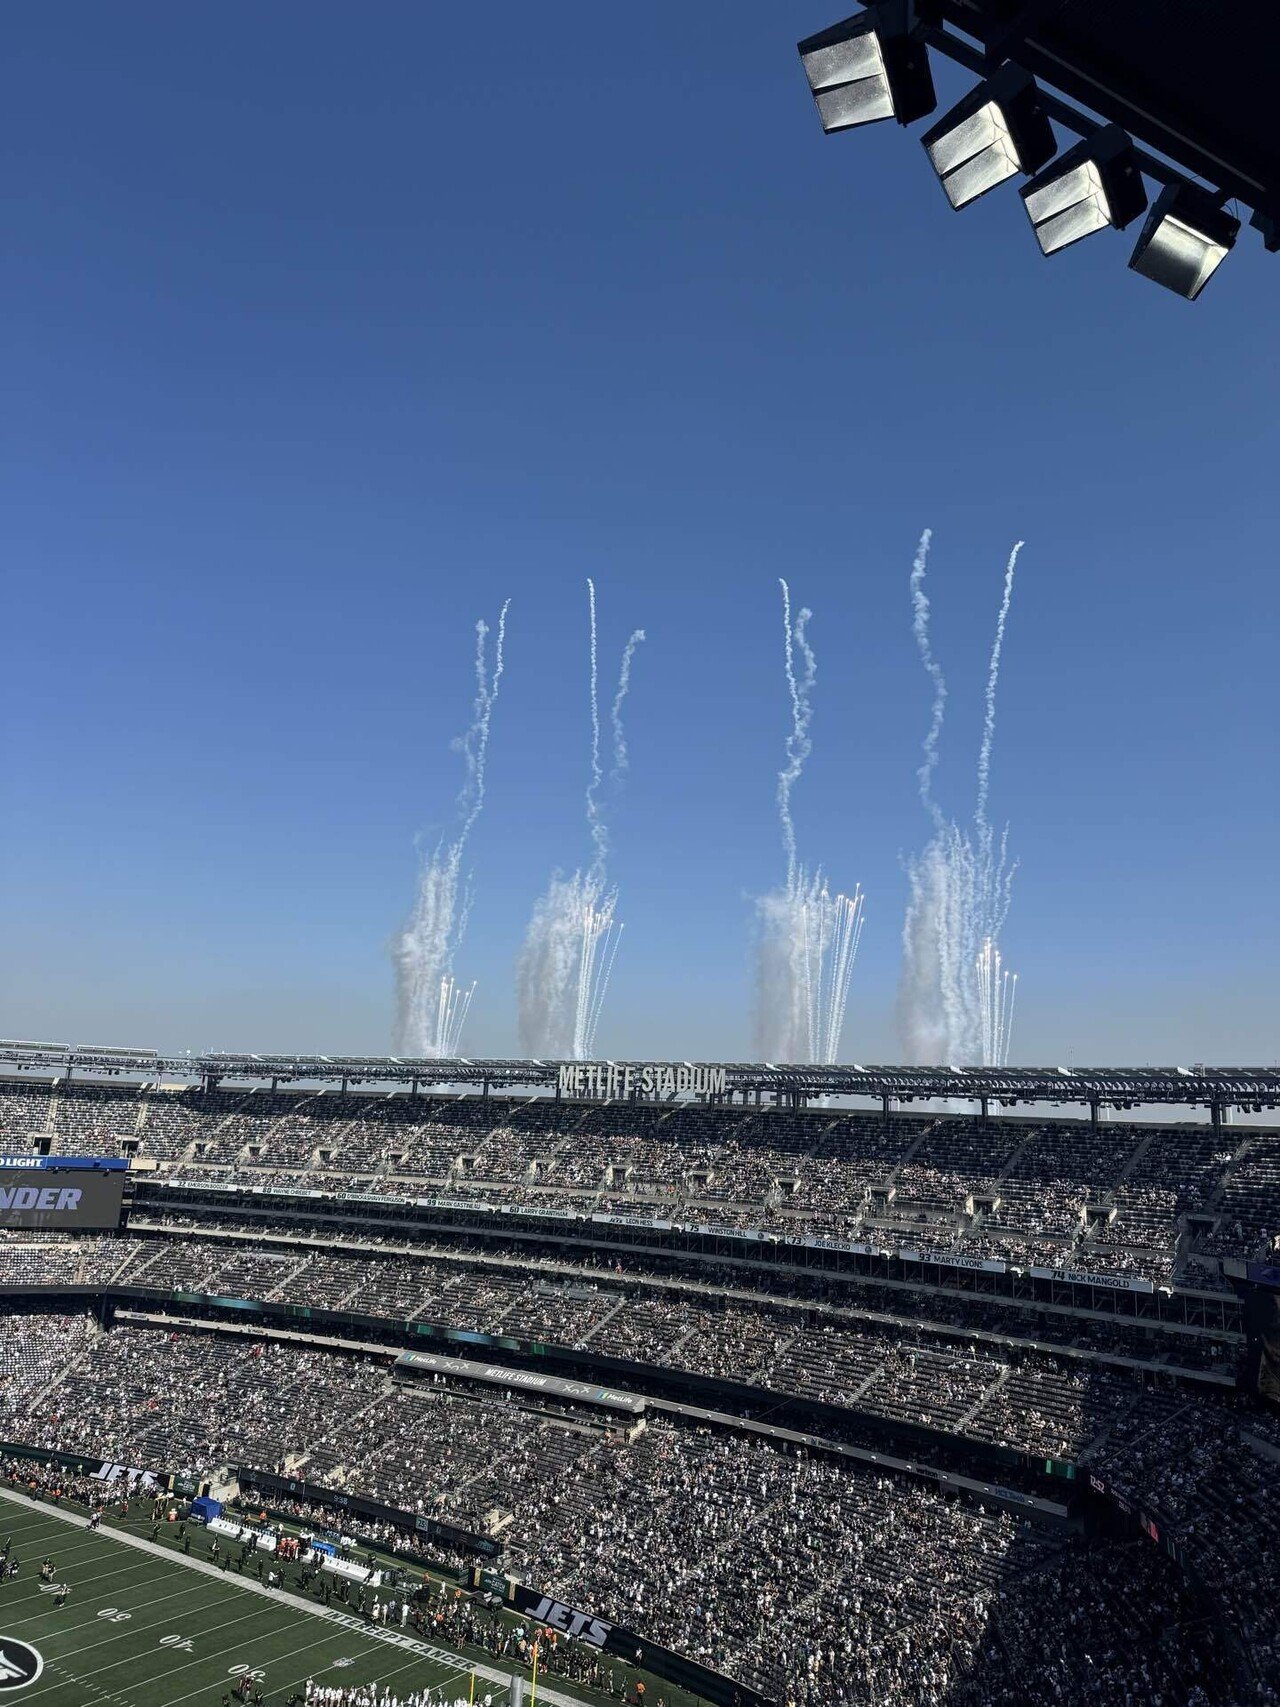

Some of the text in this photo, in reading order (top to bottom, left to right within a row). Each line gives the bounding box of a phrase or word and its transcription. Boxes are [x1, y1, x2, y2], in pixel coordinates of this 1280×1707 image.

[559, 1065, 726, 1095] METLIFE STADIUM
[6, 1158, 43, 1168] LIGHT
[0, 1187, 82, 1210] NDER
[438, 1200, 452, 1208] MARK
[453, 1202, 481, 1210] GASTINEAU
[520, 1207, 538, 1215] LARRY
[539, 1209, 568, 1217] GRANTHAM
[640, 1219, 653, 1227] HESS
[689, 1224, 747, 1238] 75 WINSTON HILL
[791, 1236, 850, 1251] 73 JOE KLECKO
[918, 1252, 983, 1269] 93 MARTY LYONS
[1051, 1271, 1130, 1289] 74 NICK MANGOLD
[414, 1355, 437, 1365] MetLife
[485, 1368, 547, 1387] METLIFE STADIUM
[607, 1393, 632, 1404] MetLife
[97, 1607, 132, 1623] 50
[525, 1597, 613, 1647] JETS
[159, 1634, 195, 1649] 40
[324, 1611, 478, 1671] INTERCEPT CANCER
